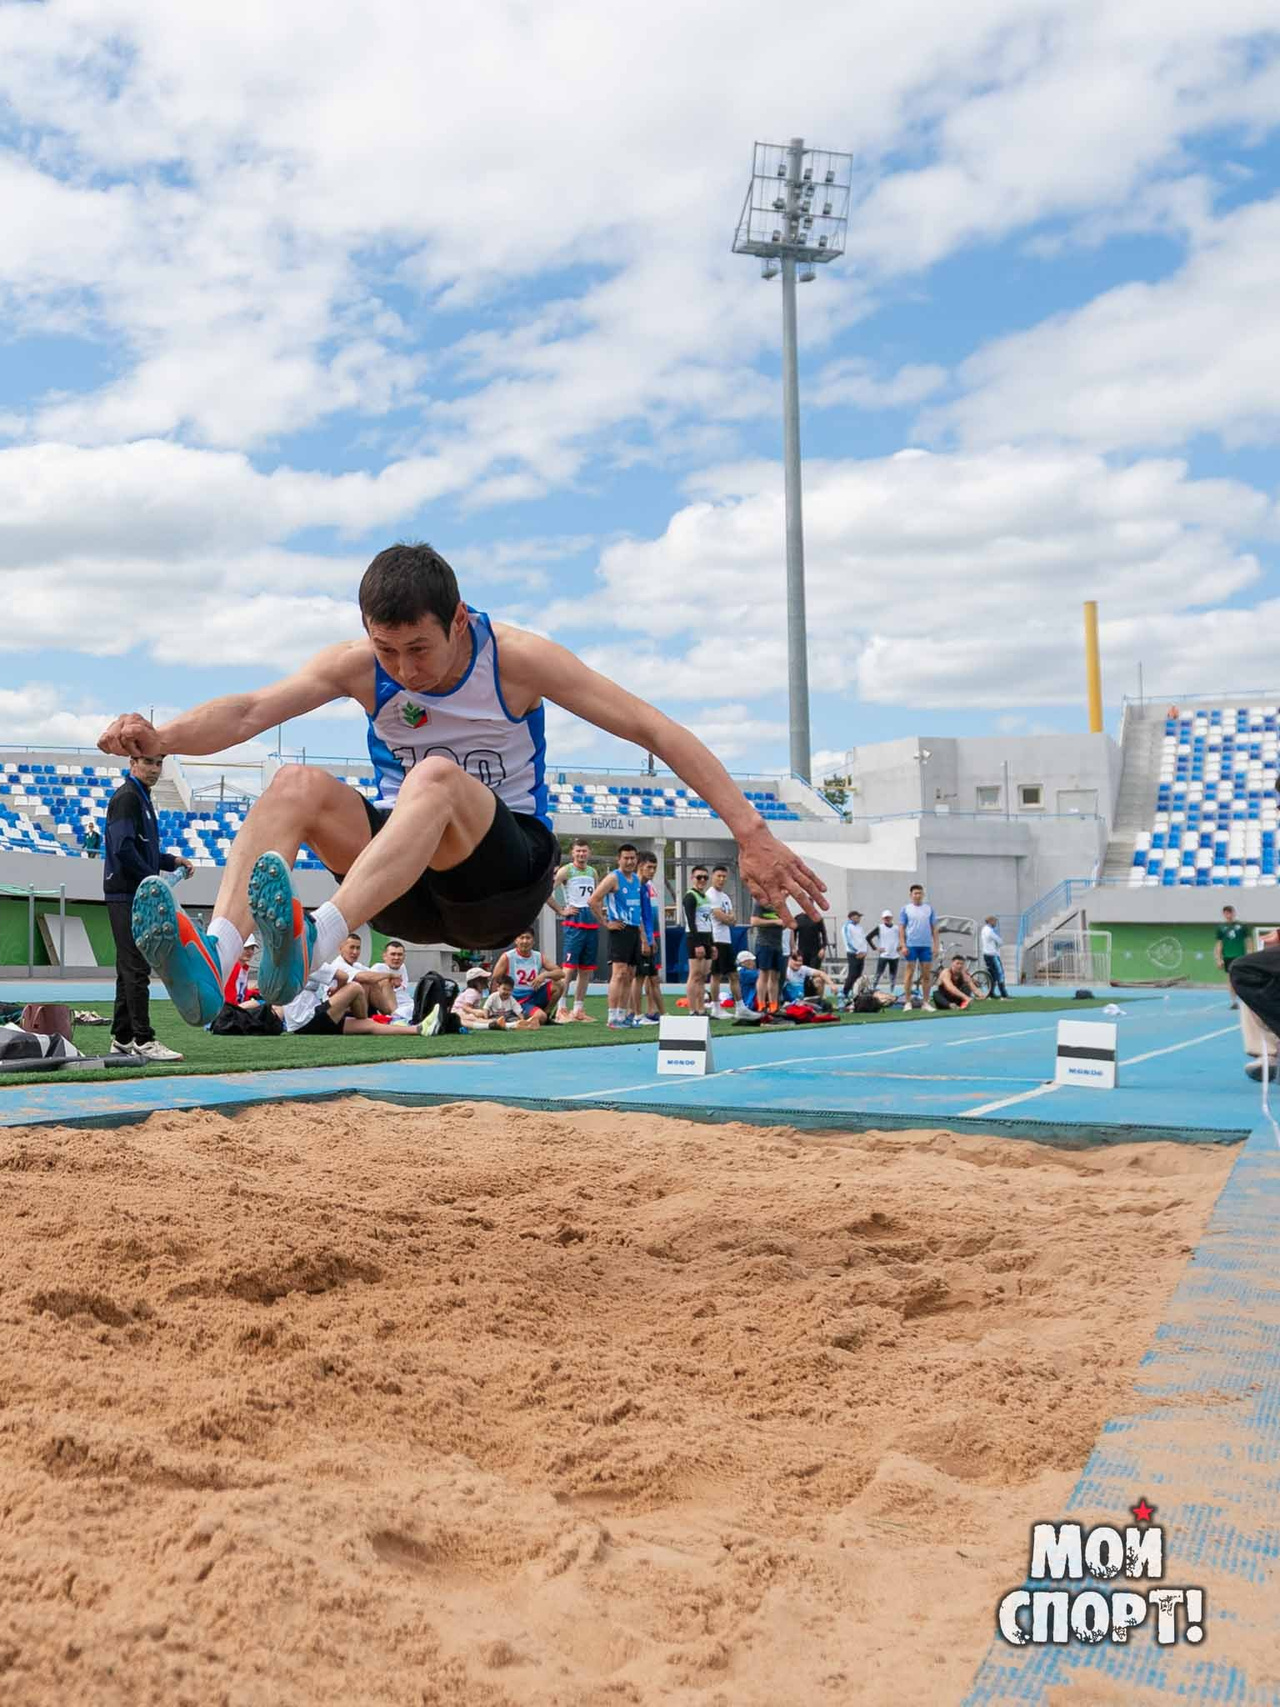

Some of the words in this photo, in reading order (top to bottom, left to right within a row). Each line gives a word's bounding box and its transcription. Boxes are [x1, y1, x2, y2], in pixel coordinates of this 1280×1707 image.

[392, 746, 507, 790] 10
[591, 817, 625, 830] ВЫХОД
[579, 886, 594, 898] 79
[516, 969, 537, 985] 24
